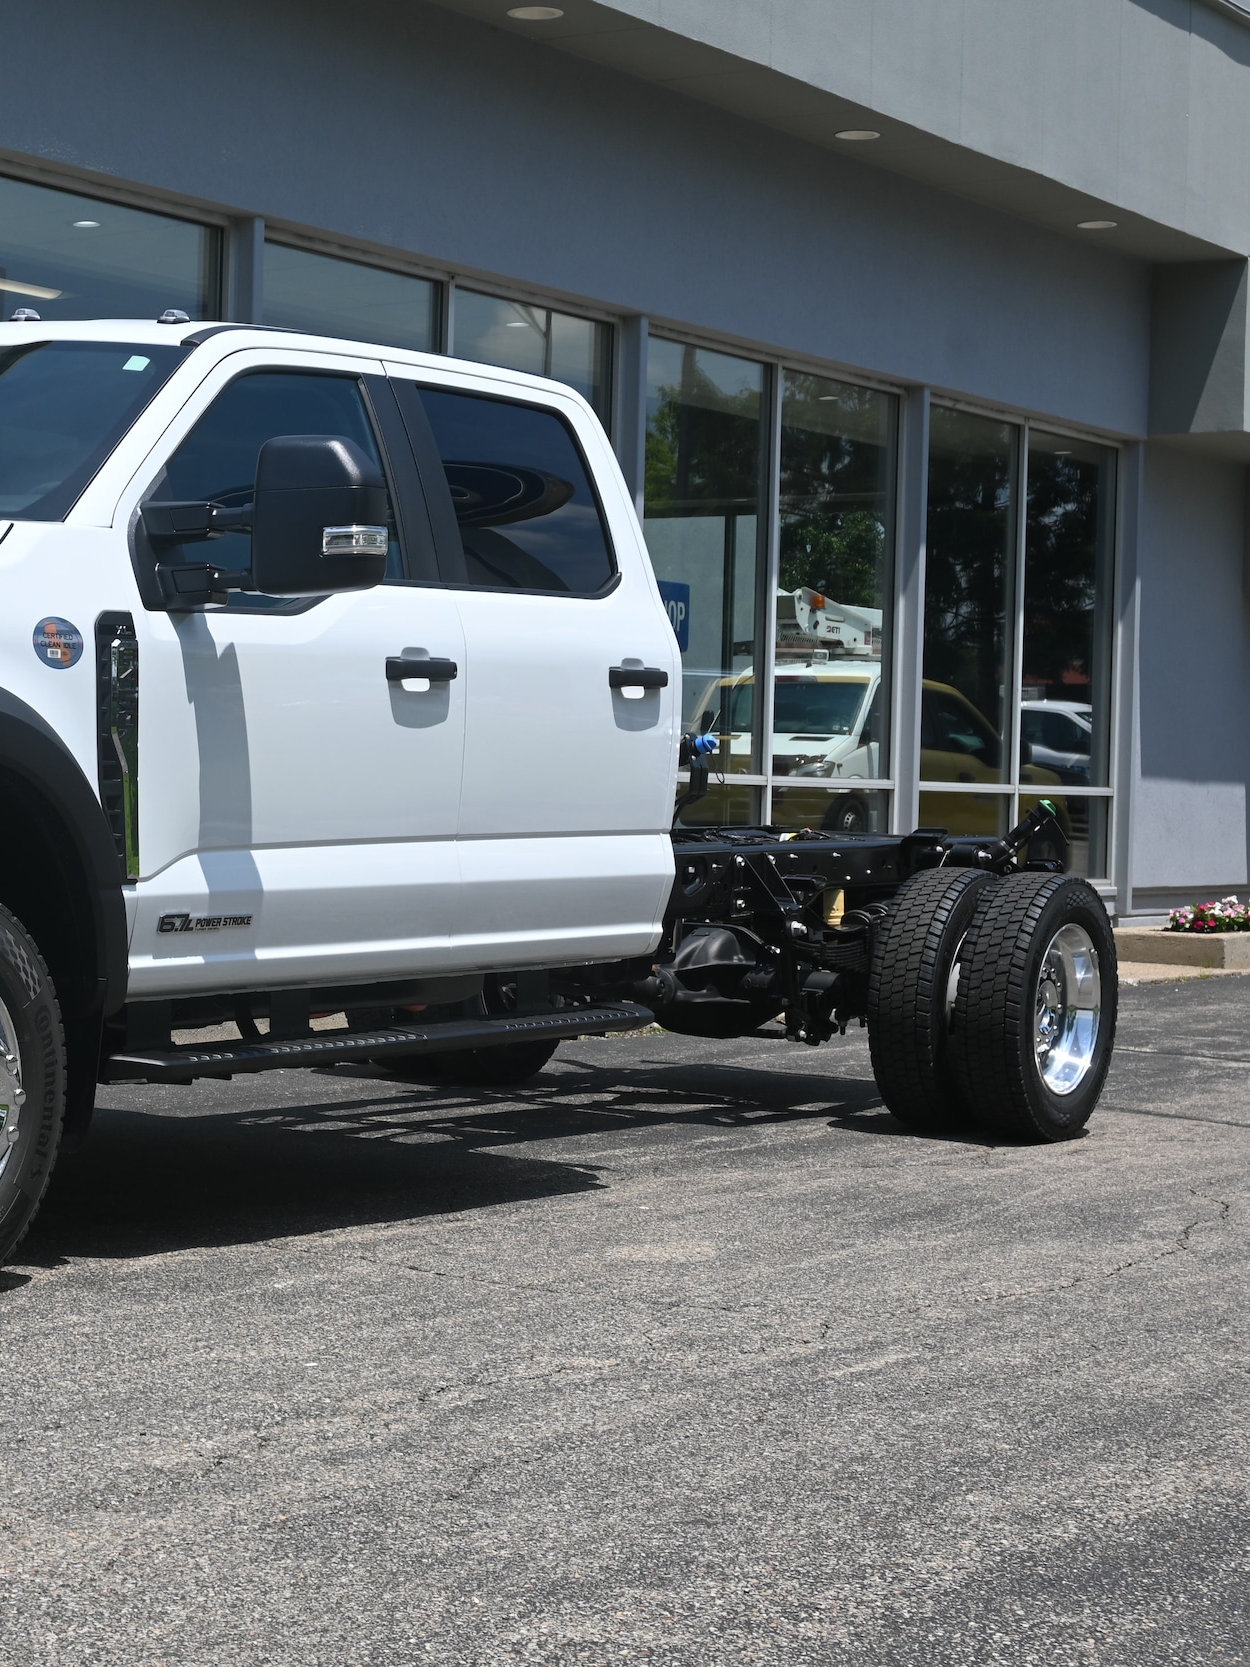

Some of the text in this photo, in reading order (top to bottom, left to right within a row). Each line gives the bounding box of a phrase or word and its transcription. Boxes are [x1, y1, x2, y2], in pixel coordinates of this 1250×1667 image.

[663, 600, 685, 632] OP
[195, 918, 222, 928] POWER
[222, 916, 253, 927] STROKE
[35, 1005, 58, 1159] Continental
